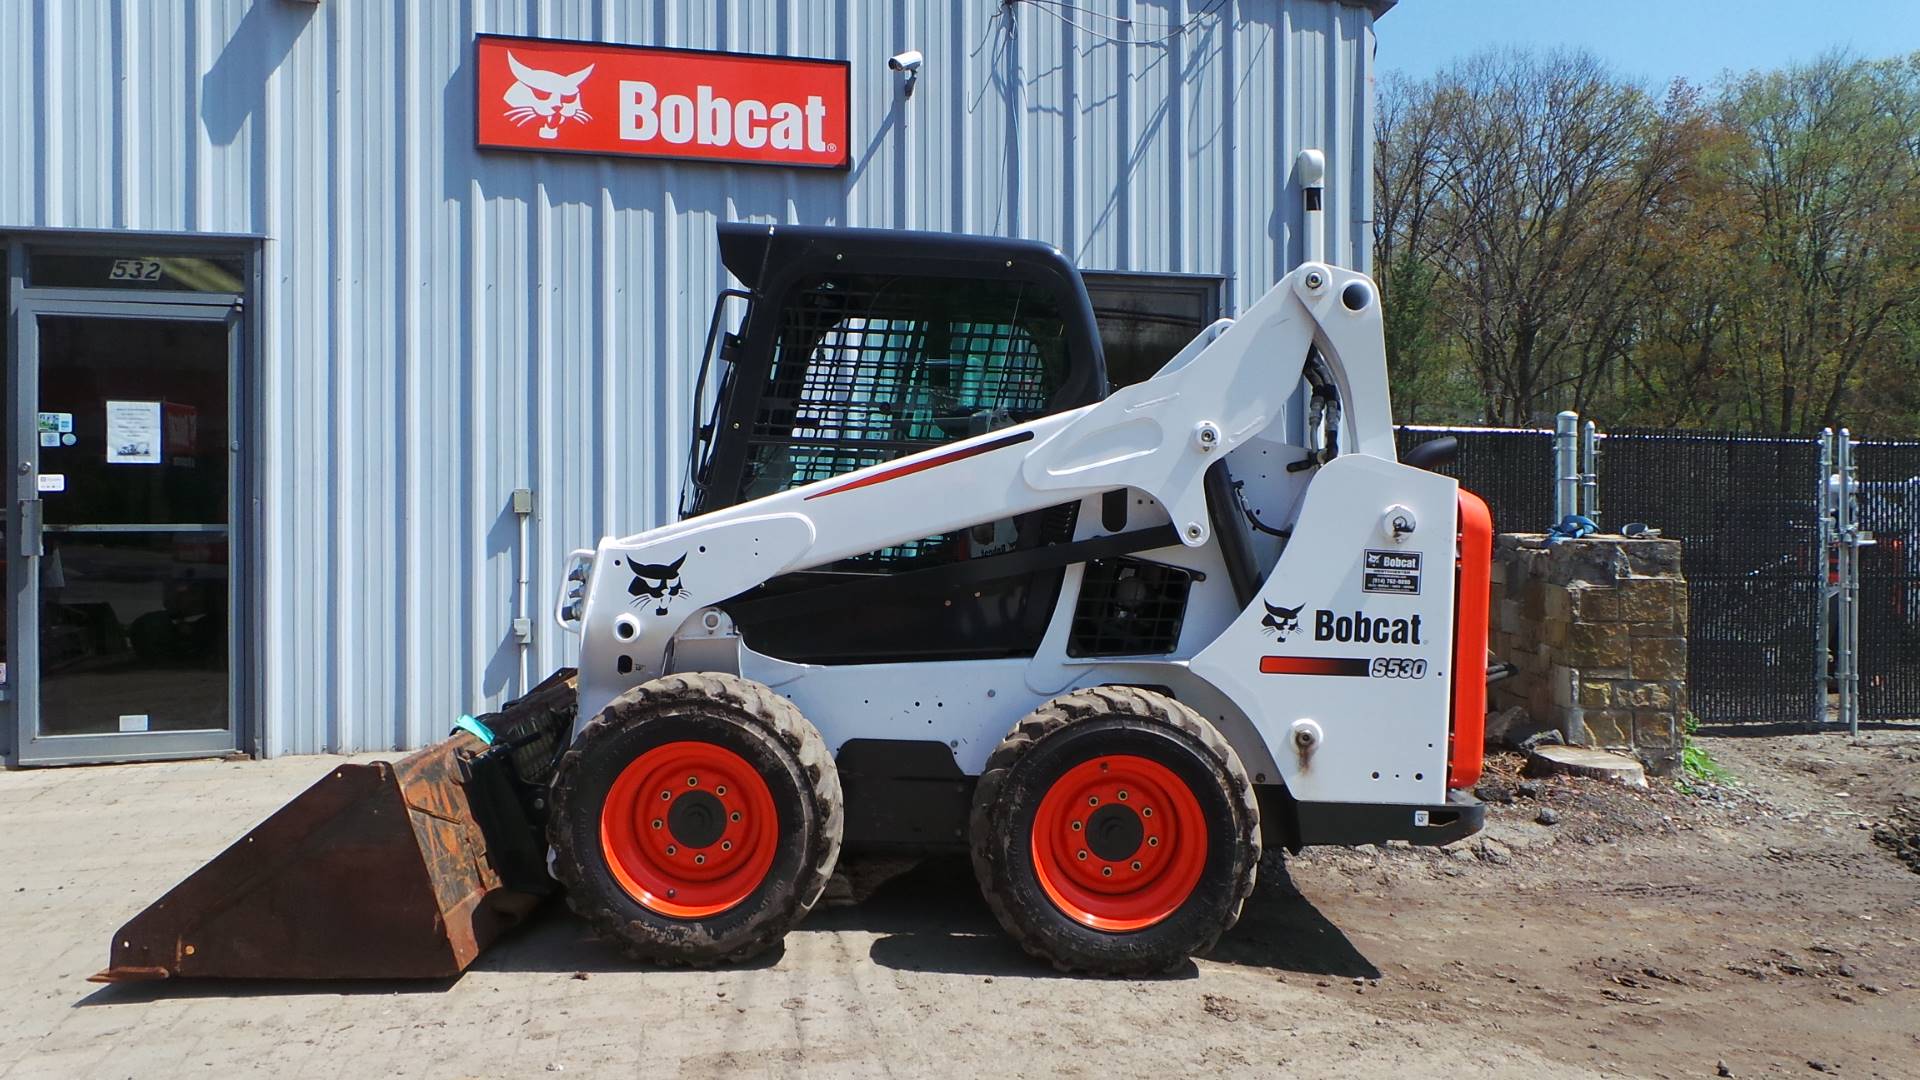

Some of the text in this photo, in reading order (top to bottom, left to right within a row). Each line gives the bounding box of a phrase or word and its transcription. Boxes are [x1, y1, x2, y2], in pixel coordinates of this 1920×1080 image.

[113, 261, 160, 279] 532
[1383, 556, 1416, 568] Bobcat
[1315, 609, 1421, 645] Bobcat
[1372, 658, 1427, 679] S530
